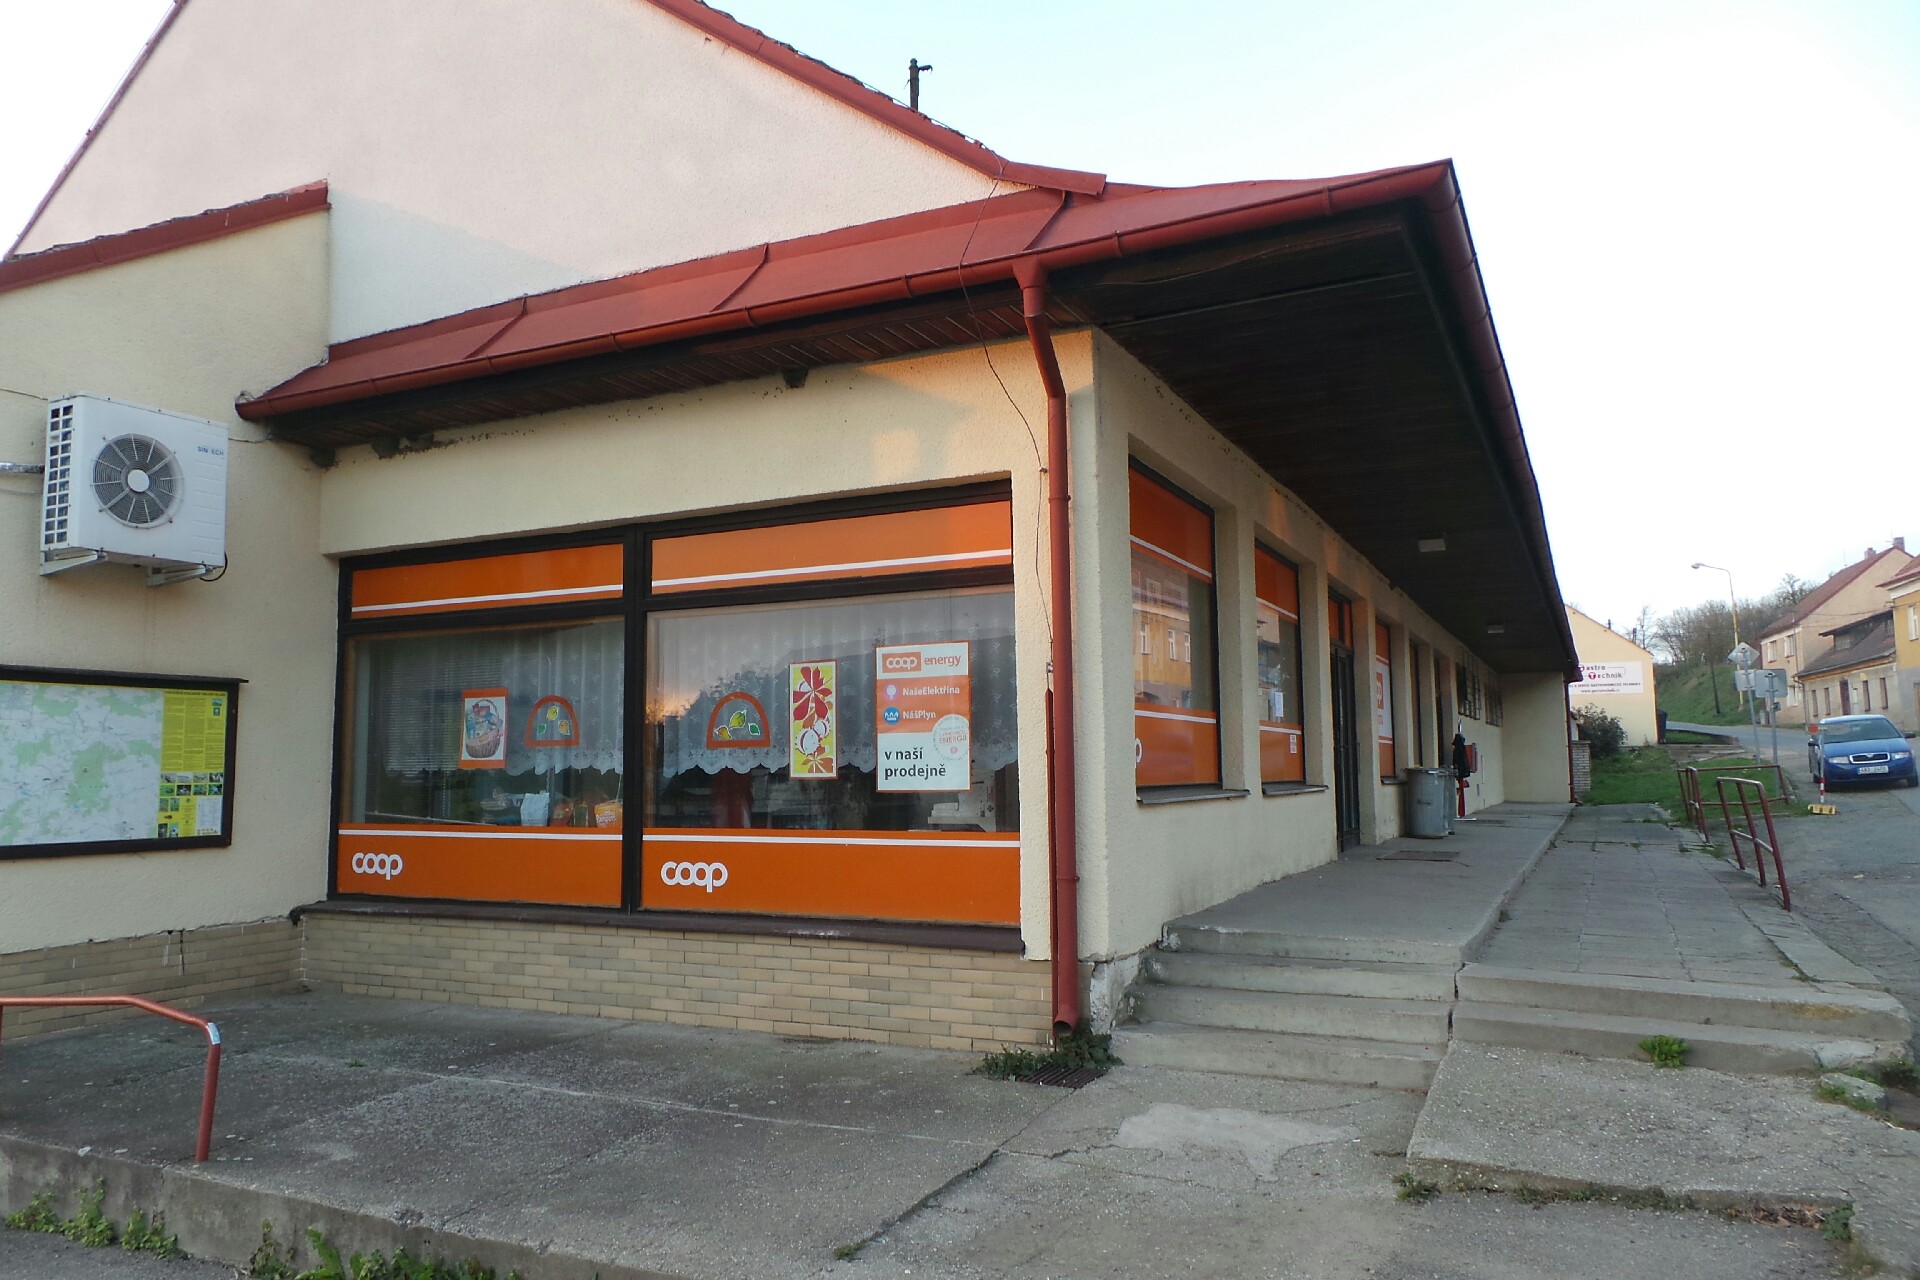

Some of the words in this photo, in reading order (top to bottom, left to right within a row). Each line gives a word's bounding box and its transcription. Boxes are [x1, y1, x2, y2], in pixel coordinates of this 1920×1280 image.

[886, 656, 918, 670] coop
[924, 655, 961, 667] energy
[902, 685, 960, 696] NašeElektřina
[902, 709, 937, 720] NášPlyn
[884, 751, 892, 760] v
[895, 747, 924, 760] naší
[884, 763, 946, 780] prodejně
[352, 852, 403, 880] coop
[661, 861, 728, 893] coop
